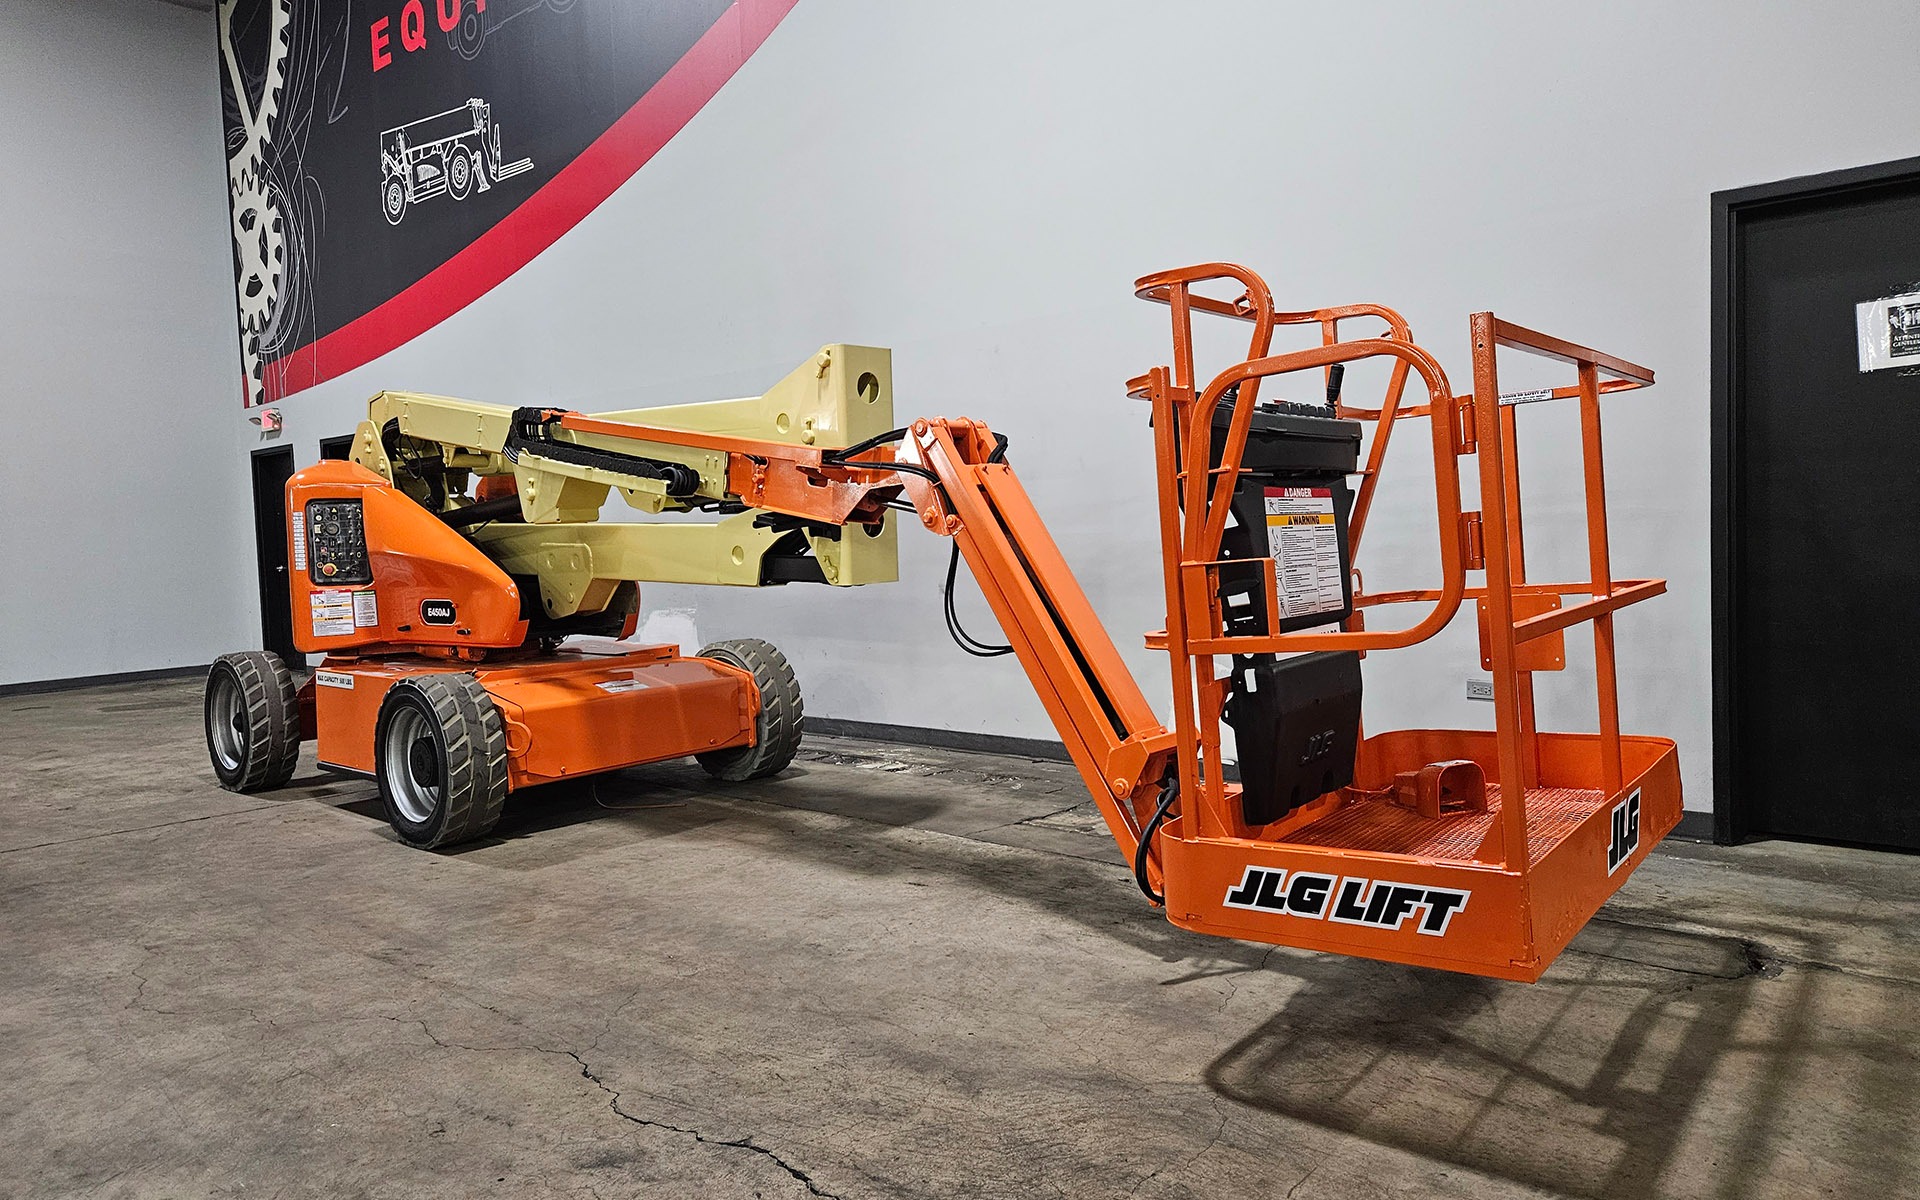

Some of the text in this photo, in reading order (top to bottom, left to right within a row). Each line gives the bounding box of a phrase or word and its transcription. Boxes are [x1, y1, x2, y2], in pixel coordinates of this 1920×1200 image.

[370, 0, 486, 72] EQU
[1289, 487, 1313, 498] DANGER
[1293, 515, 1320, 525] WARNING
[427, 607, 450, 617] E450AJ
[324, 675, 339, 684] CAPACITY
[1608, 791, 1640, 871] JLG
[1227, 868, 1465, 932] JLG LIFT
